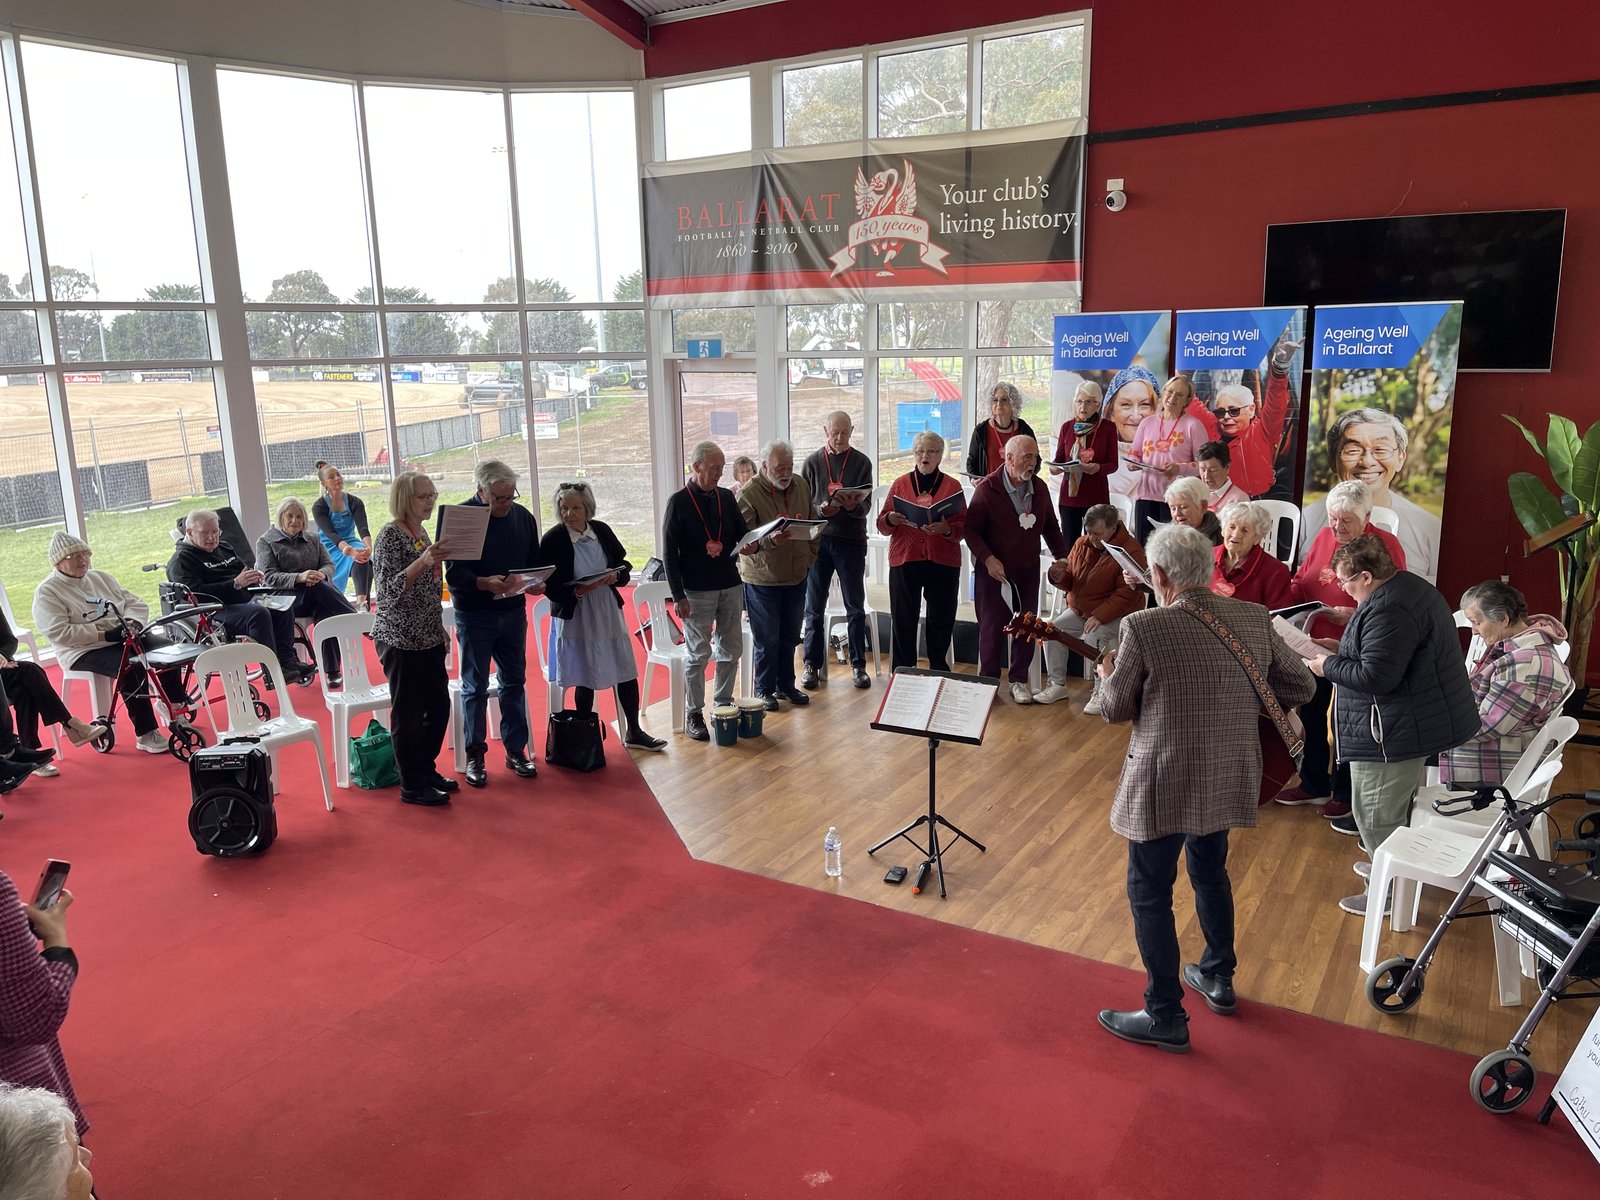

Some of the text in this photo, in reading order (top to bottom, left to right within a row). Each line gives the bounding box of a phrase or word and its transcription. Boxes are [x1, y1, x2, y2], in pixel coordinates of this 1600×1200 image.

[940, 176, 1050, 206] Your club's
[676, 193, 841, 231] BALLARAT
[856, 220, 922, 240] 150 years
[939, 208, 1078, 239] living history.
[678, 224, 840, 242] FOOTBALL & NETBALL CLUB
[716, 242, 747, 259] 1860
[764, 242, 798, 256] 2010
[1061, 331, 1129, 347] Ageing Well
[1184, 329, 1260, 345] Ageing Well
[1323, 325, 1409, 343] Ageing Well
[1061, 347, 1118, 358] in Ballarat
[1184, 345, 1247, 357] in Ballarat
[1322, 342, 1394, 356] in Ballarat
[324, 373, 354, 381] FASTENERS
